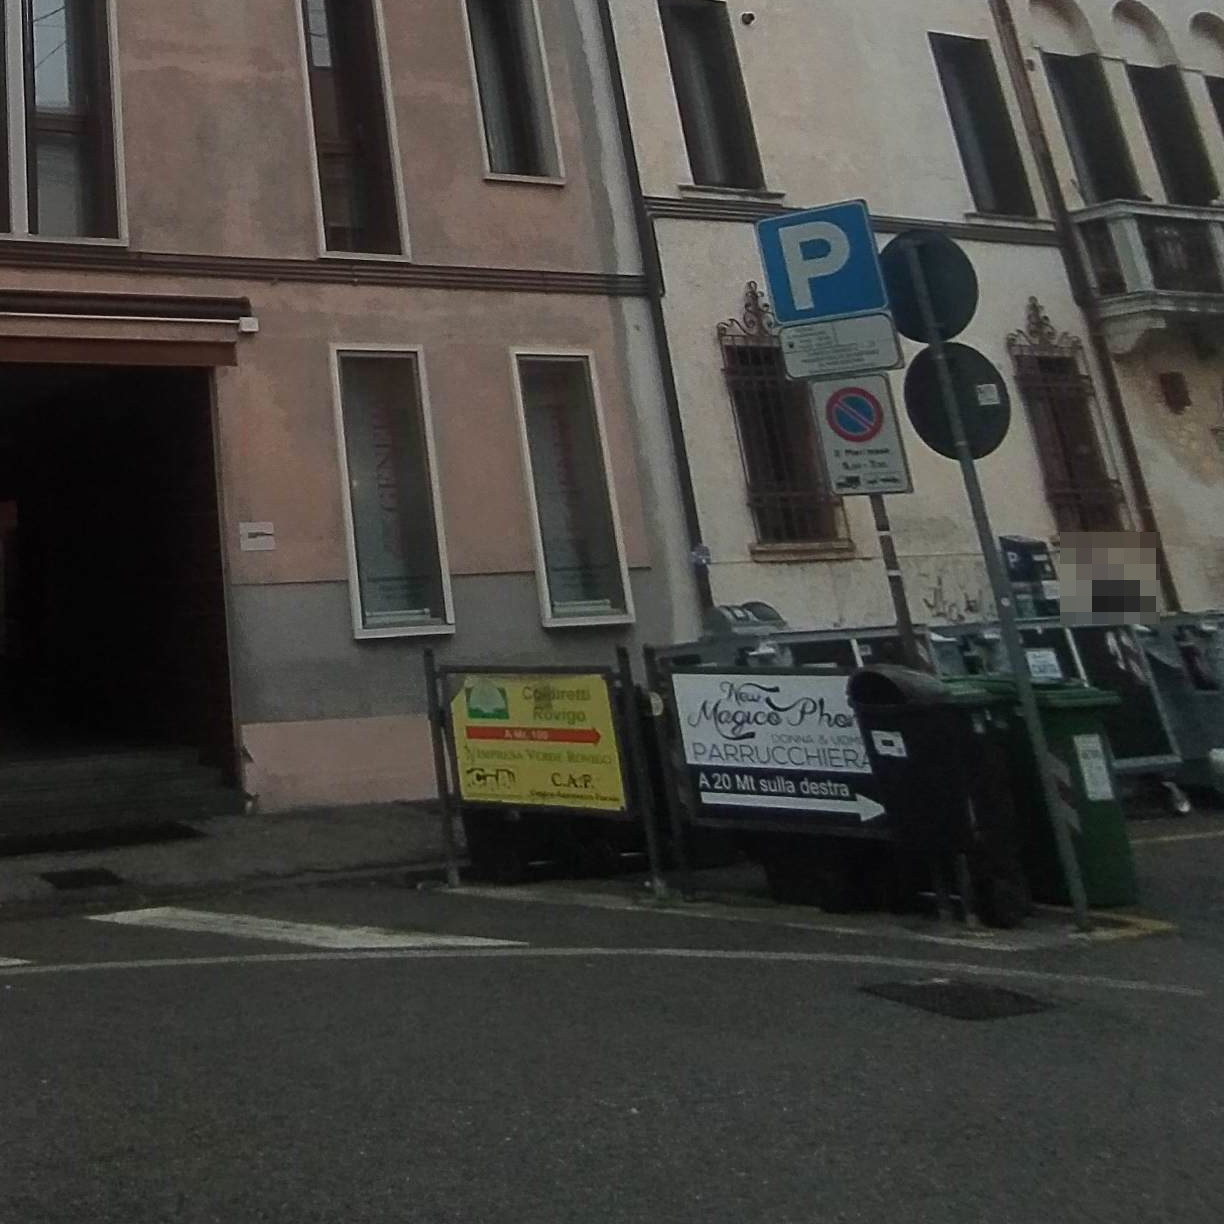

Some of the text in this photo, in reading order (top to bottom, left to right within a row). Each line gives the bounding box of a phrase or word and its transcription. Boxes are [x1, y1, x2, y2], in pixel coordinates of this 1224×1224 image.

[778, 221, 850, 311] P
[720, 681, 779, 706] New
[533, 706, 586, 725] Rovigo
[688, 697, 855, 740] Magico Pho
[699, 772, 711, 790] A
[712, 774, 731, 790] 20
[760, 776, 796, 794] sulla
[800, 778, 850, 797] destra
